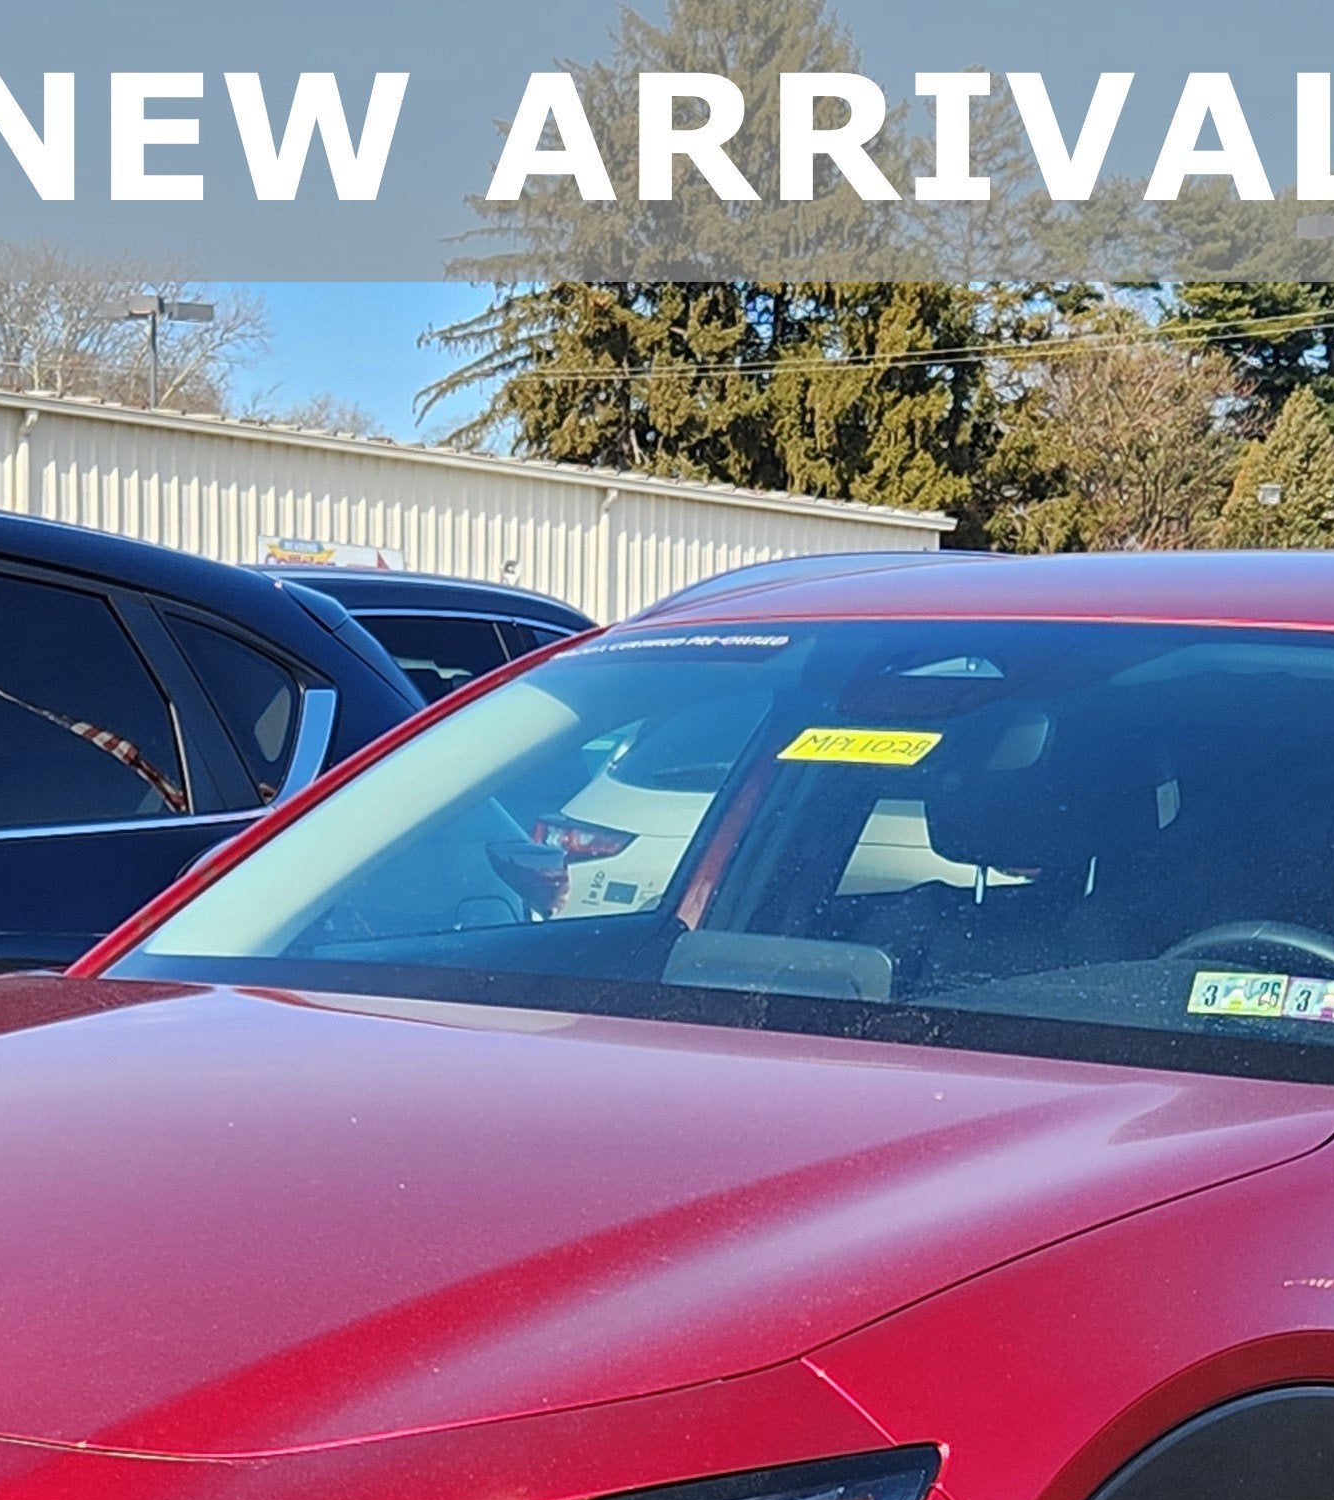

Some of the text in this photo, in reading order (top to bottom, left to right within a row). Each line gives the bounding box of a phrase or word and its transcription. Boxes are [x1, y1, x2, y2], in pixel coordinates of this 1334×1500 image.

[1204, 982, 1282, 1008] 3 26
[1296, 989, 1312, 1012] 3
